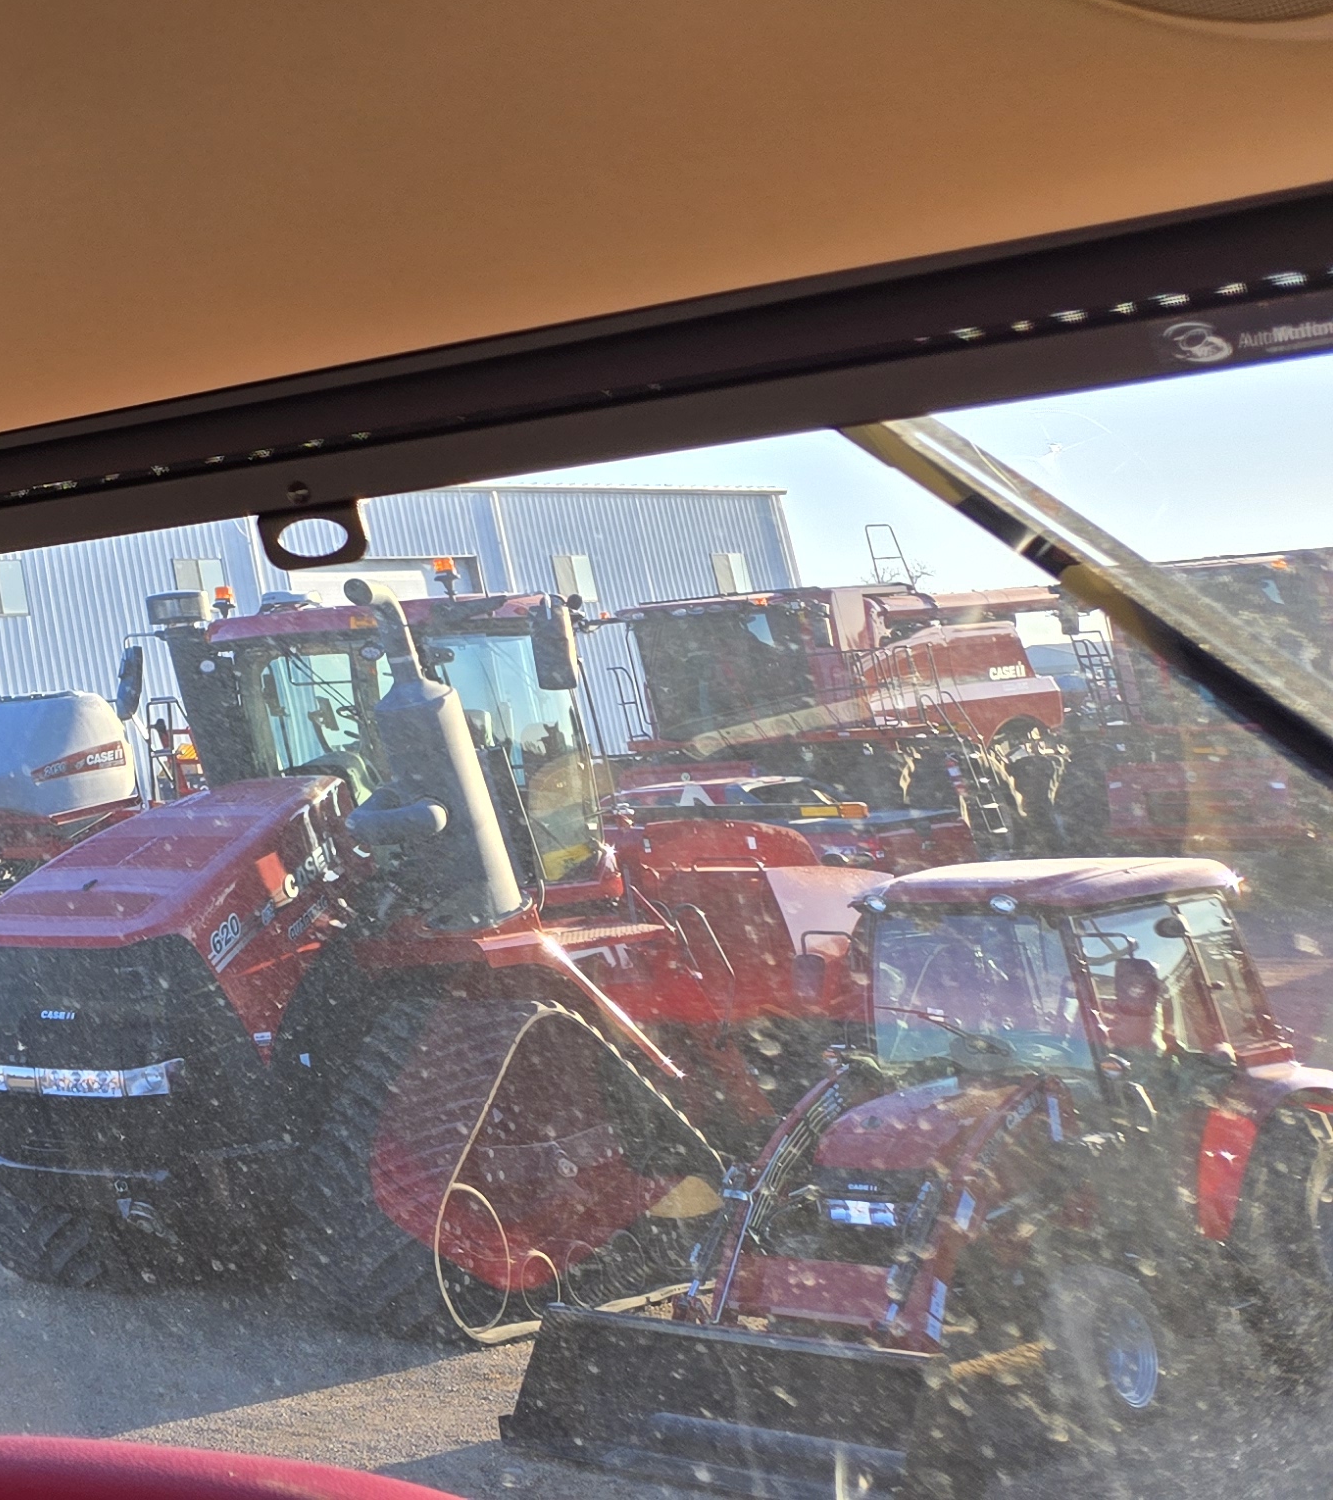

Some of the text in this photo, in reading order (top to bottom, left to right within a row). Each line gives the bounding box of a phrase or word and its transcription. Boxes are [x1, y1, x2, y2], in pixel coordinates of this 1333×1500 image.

[989, 665, 1017, 680] CASE
[86, 750, 114, 765] CASE
[284, 846, 328, 898] CASE
[210, 912, 241, 955] 620
[40, 1010, 65, 1020] CASE
